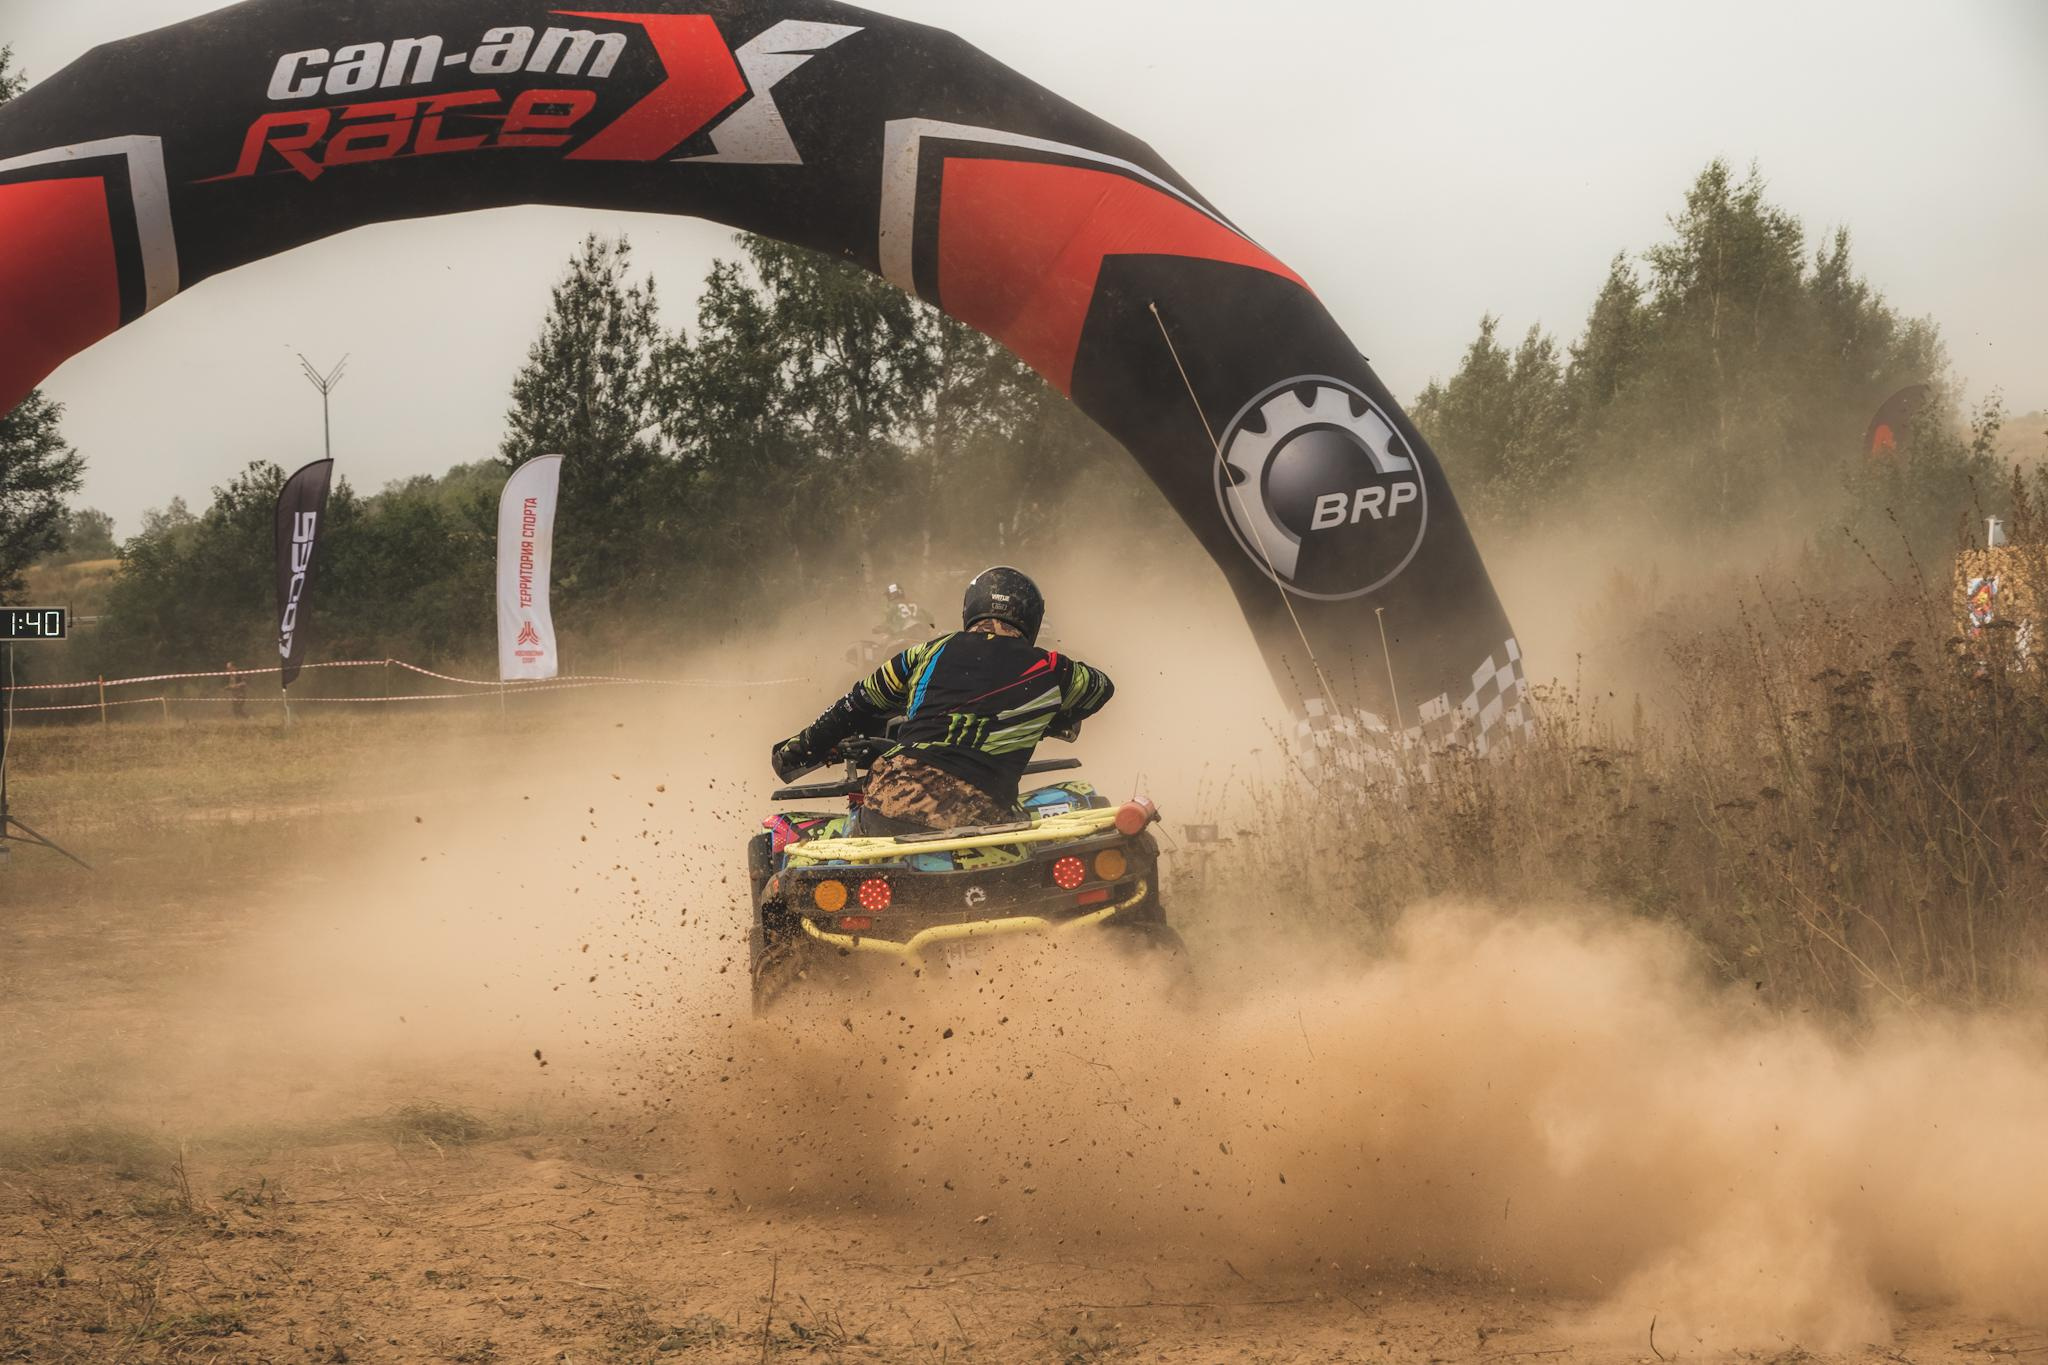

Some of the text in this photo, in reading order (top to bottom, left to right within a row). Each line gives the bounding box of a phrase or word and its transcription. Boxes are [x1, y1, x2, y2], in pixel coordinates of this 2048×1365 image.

[266, 26, 627, 101] can-am
[1309, 481, 1418, 531] BRP
[519, 497, 538, 609] ТЕРРИТОРИЯ СПОРТА
[12, 612, 60, 636] 1:40
